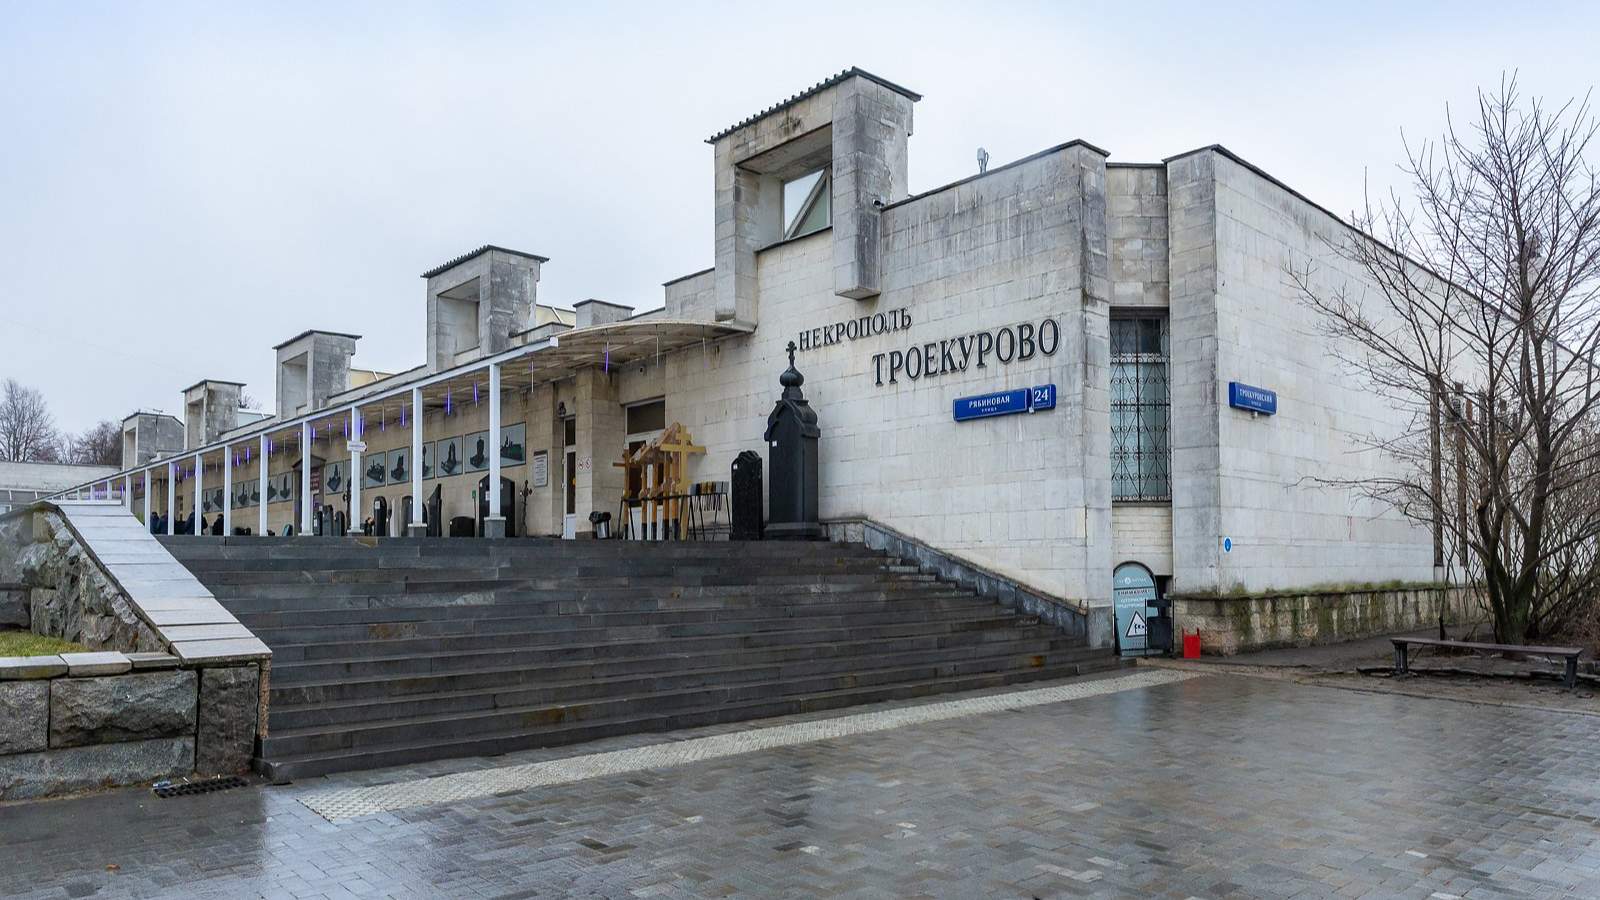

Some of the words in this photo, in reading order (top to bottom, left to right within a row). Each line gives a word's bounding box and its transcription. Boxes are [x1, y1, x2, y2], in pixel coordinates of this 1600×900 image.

[799, 307, 912, 352] НЕКРОПОЛЬ
[872, 318, 1060, 386] ТРОЕКУРОВО
[968, 395, 1010, 408] РЯБИНОВАЯ
[1034, 388, 1048, 402] 24
